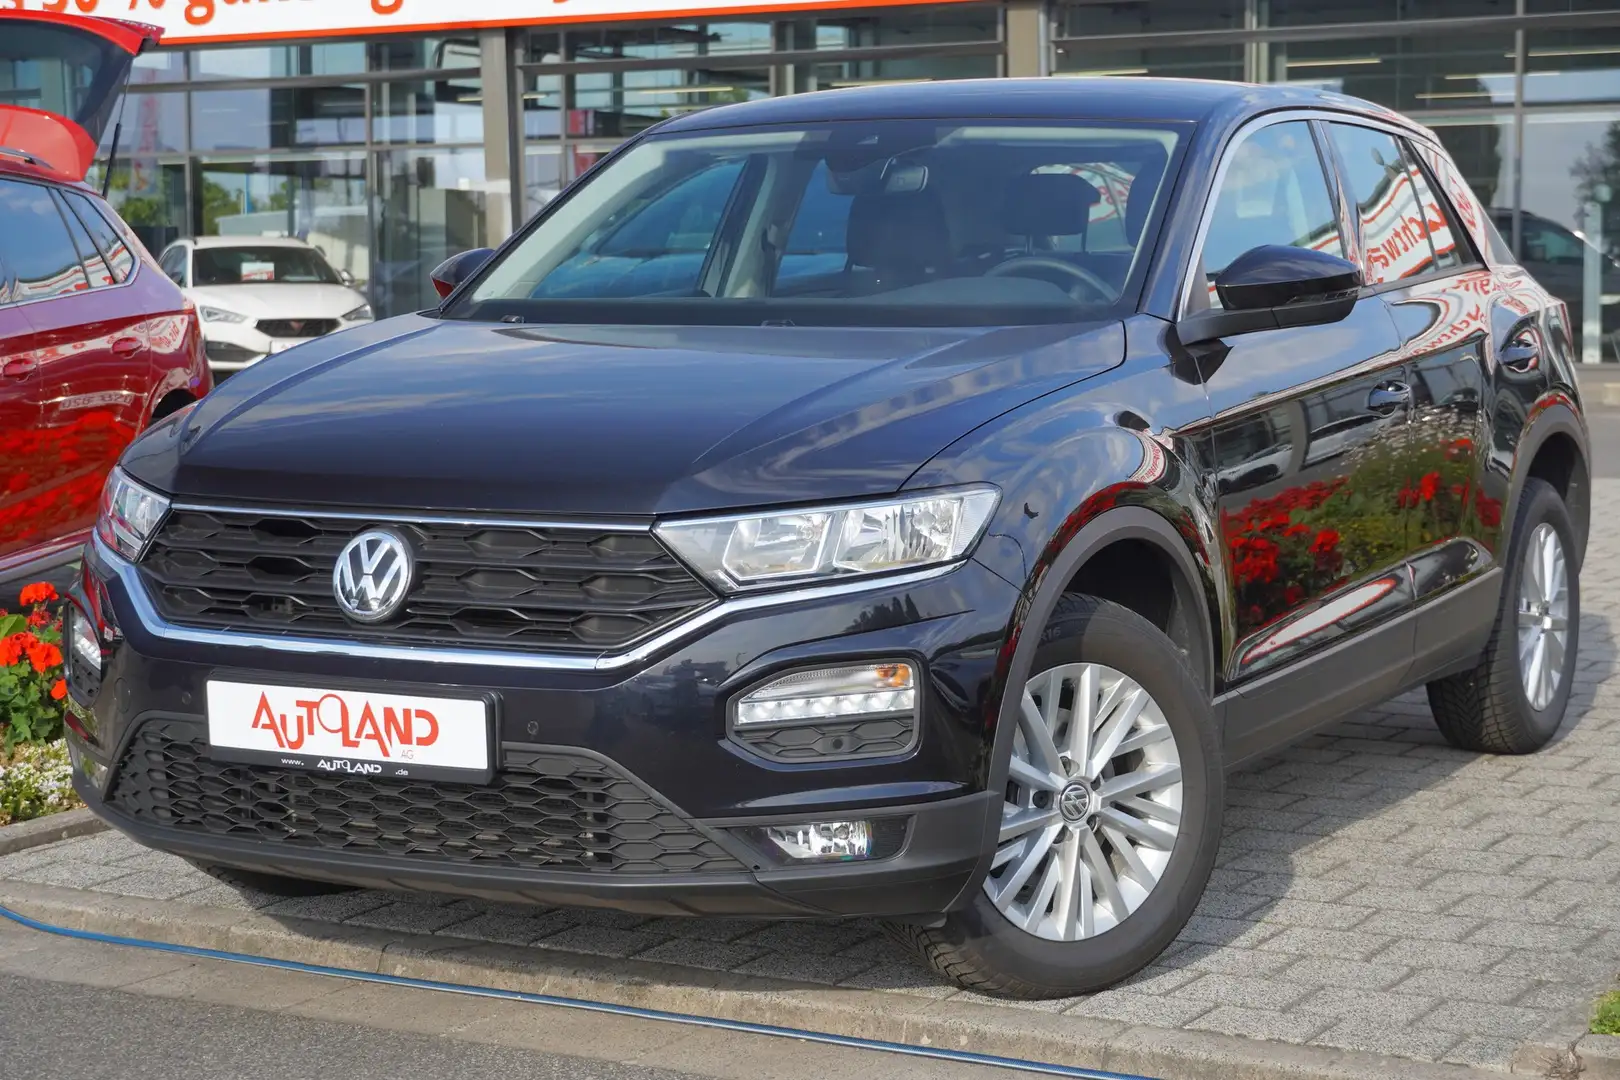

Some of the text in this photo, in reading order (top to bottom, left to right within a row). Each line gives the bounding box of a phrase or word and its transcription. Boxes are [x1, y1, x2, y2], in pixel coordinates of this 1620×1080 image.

[334, 532, 409, 618] VW
[401, 750, 414, 760] AG
[281, 758, 304, 766] www.
